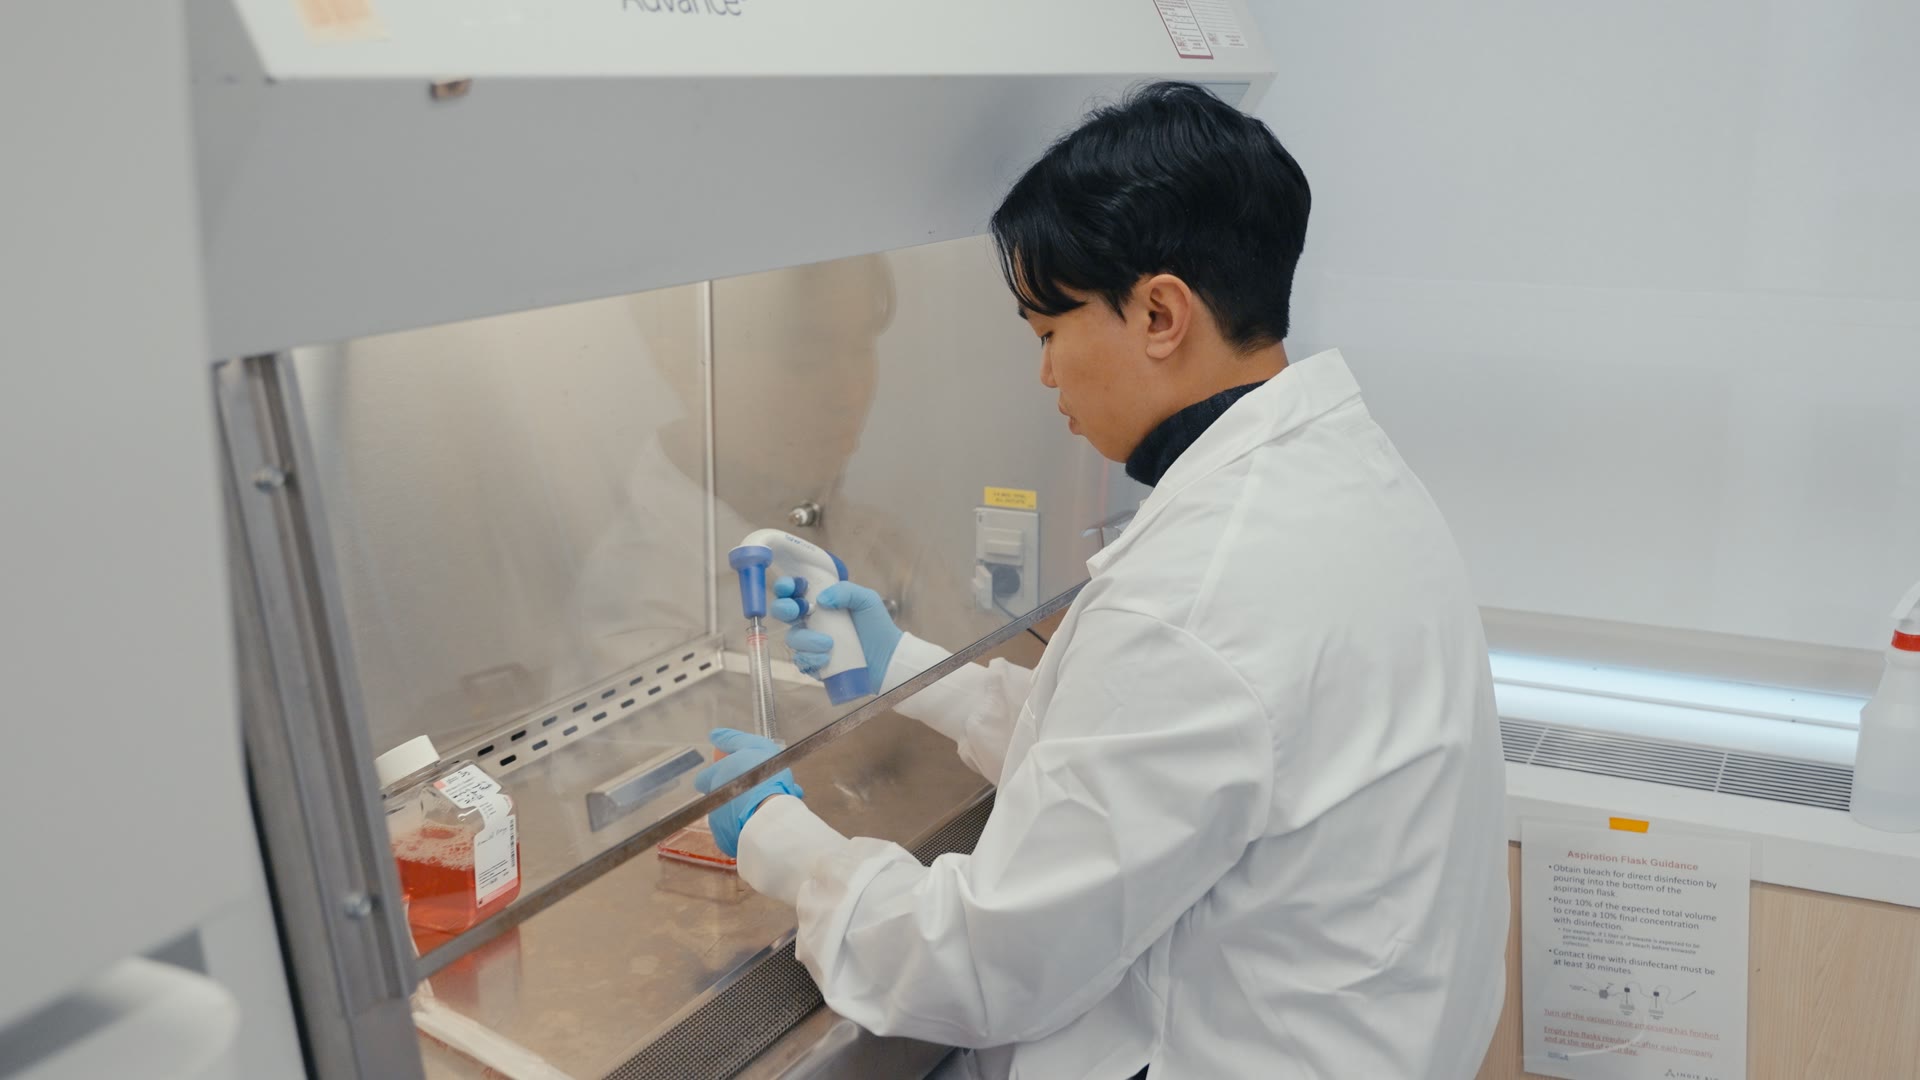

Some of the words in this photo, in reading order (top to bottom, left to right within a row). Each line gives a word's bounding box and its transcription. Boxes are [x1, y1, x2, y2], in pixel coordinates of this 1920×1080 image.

[1567, 850, 1618, 862] Aspiration
[1621, 856, 1648, 865] Flask
[1650, 858, 1699, 871] Guidance
[1553, 864, 1581, 874] Obtain
[1583, 867, 1610, 877] bleach
[1613, 870, 1624, 878] for
[1627, 871, 1651, 882] direct
[1654, 874, 1704, 887] disinfection
[1706, 880, 1717, 889] by
[1553, 875, 1585, 886] pouring
[1587, 878, 1604, 886] into
[1606, 880, 1620, 888] the
[1622, 881, 1654, 892] bottom
[1667, 886, 1682, 895] the
[1553, 884, 1594, 895] aspiration
[1553, 896, 1572, 905] Pour
[1576, 899, 1592, 908] 10%
[1622, 904, 1660, 915] expected
[1662, 909, 1682, 917] total
[1684, 912, 1717, 922] volume
[1564, 908, 1590, 917] create
[1600, 911, 1617, 920] 10%
[1620, 914, 1638, 922] final
[1640, 917, 1699, 929] concentration
[1553, 948, 1584, 959] Contact
[1629, 958, 1677, 970] disinfectant
[1681, 966, 1702, 974] must
[1563, 959, 1583, 968] least
[1585, 962, 1596, 970] 30
[1544, 1008, 1560, 1017] Turn
[1586, 1016, 1614, 1024] vacuum
[1674, 1027, 1688, 1035] has
[1544, 1026, 1566, 1036] Empty
[1581, 1032, 1600, 1040] flasks
[1602, 1036, 1632, 1044] regular
[1661, 1045, 1678, 1053] each
[1680, 1048, 1712, 1058] company
